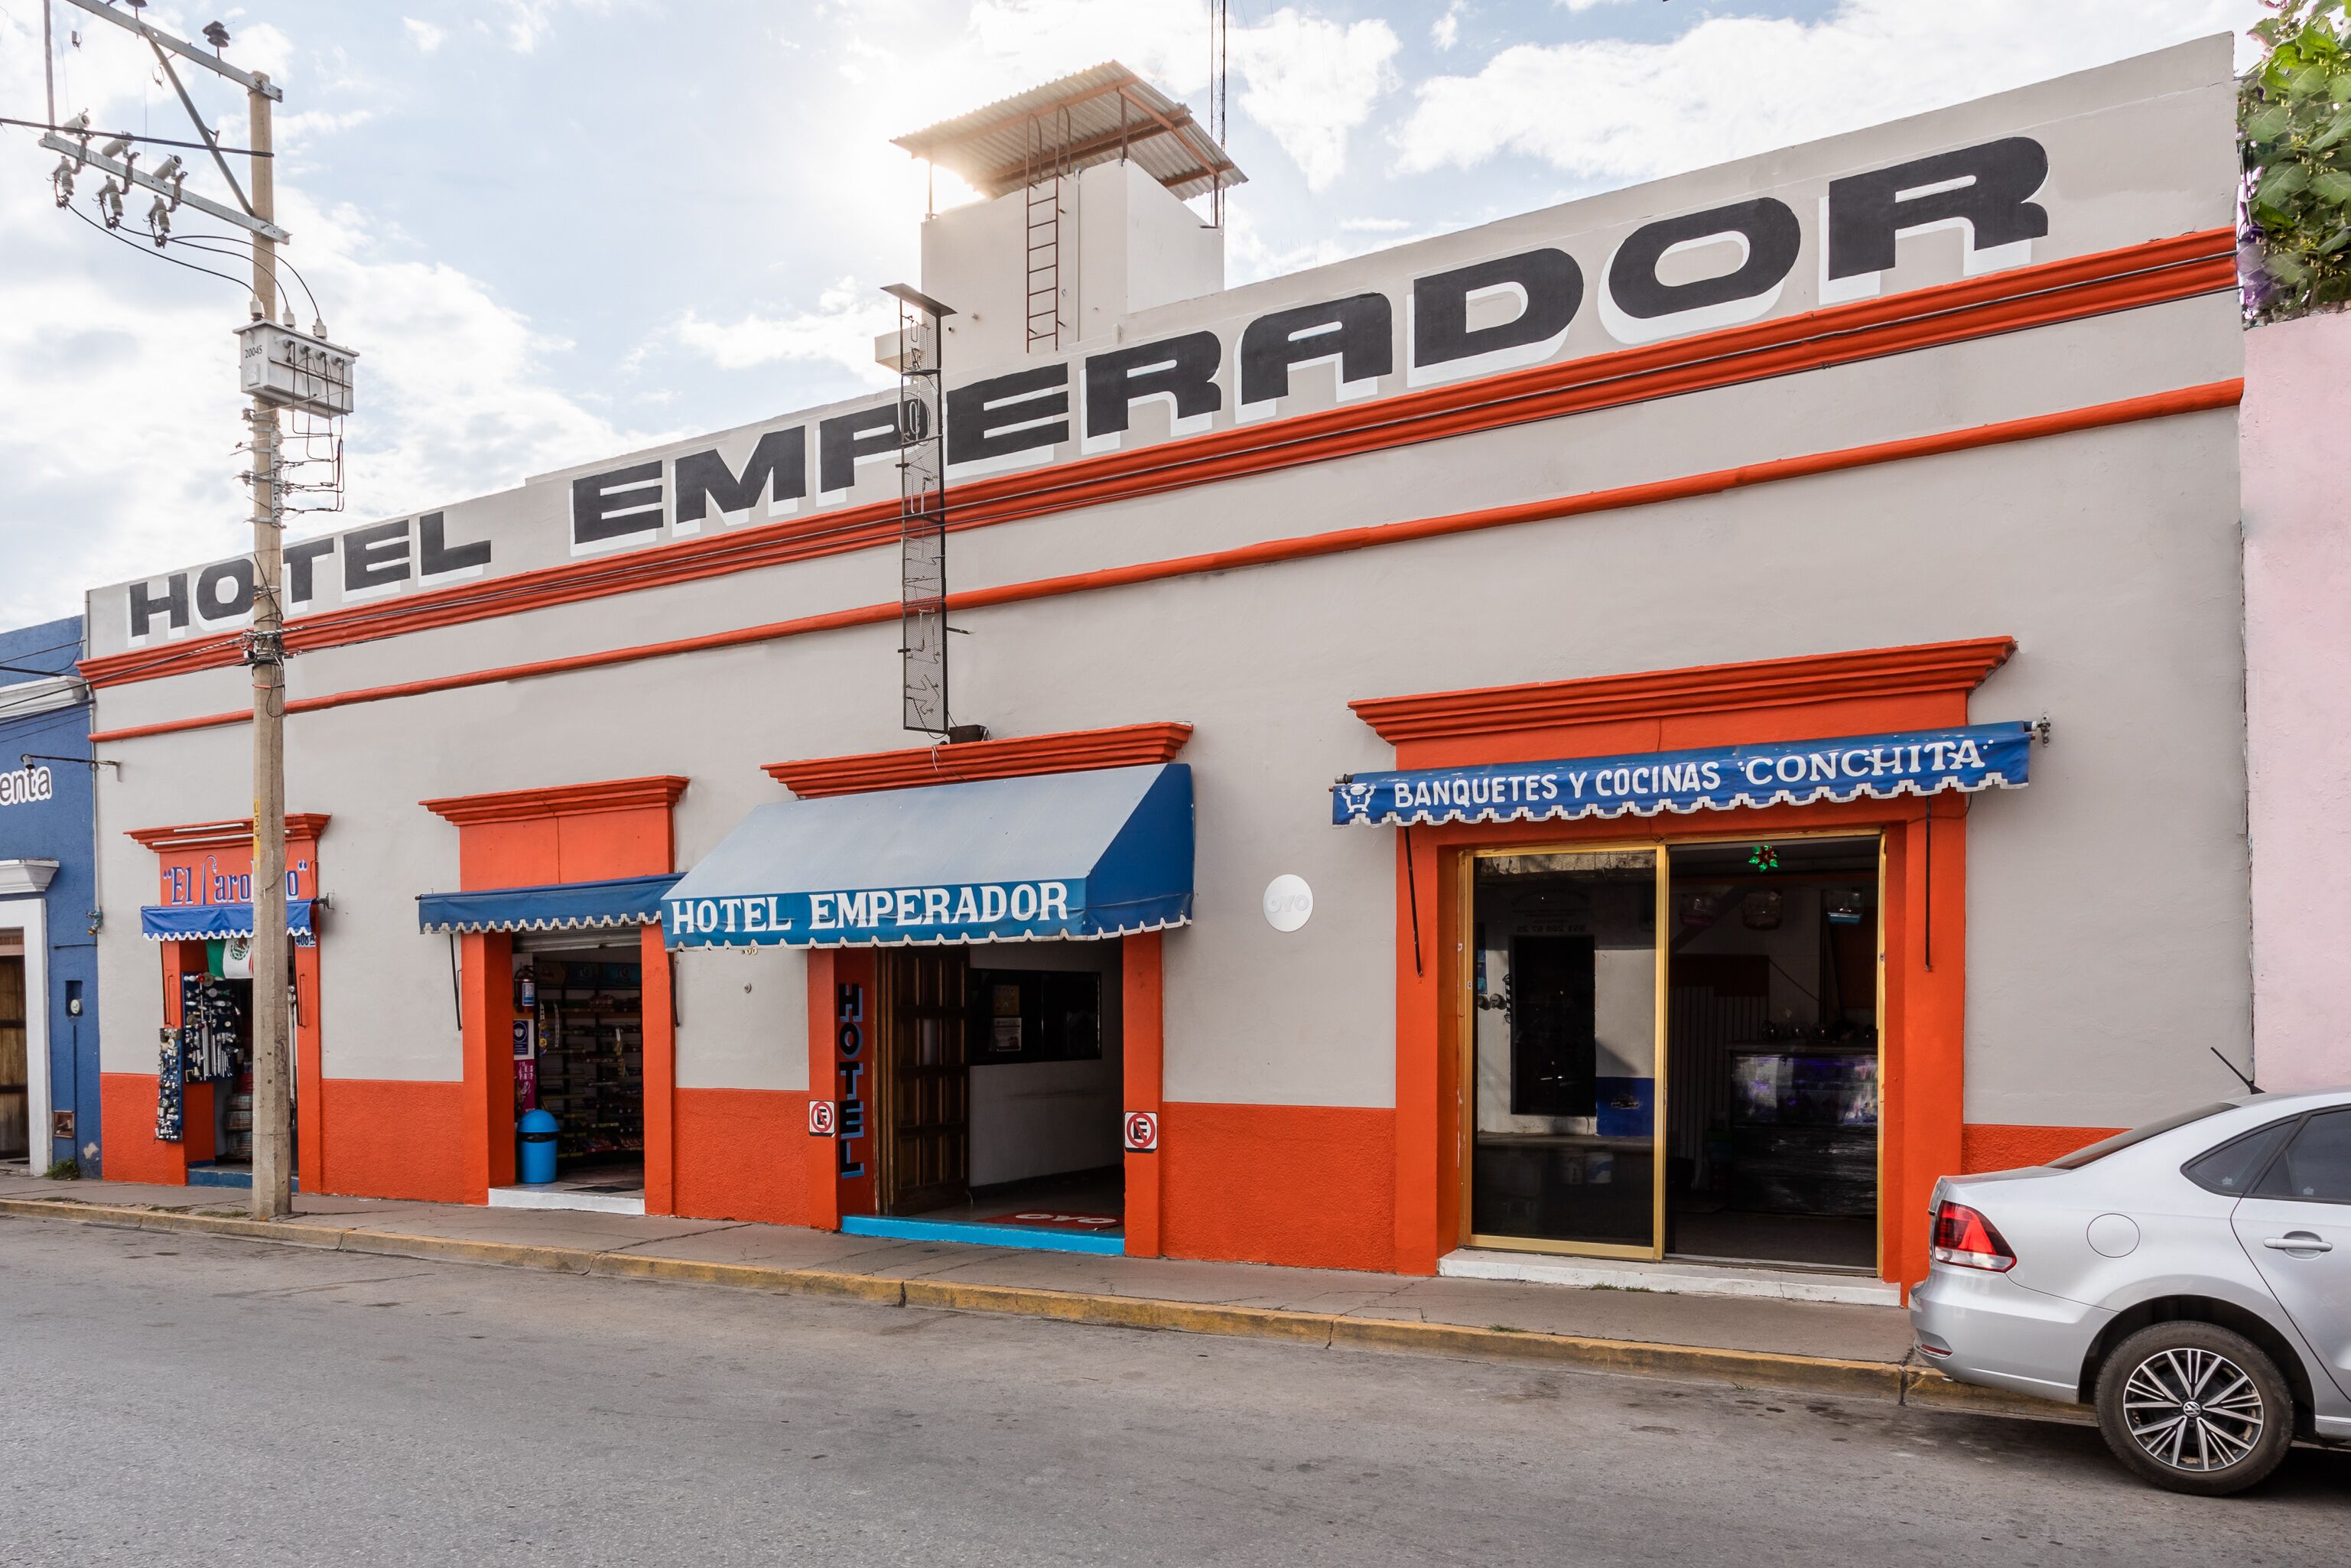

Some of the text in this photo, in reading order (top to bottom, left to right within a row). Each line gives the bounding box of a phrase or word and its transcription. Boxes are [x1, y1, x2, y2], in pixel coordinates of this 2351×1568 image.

[245, 344, 263, 359] 20045
[128, 511, 492, 646] HOTEL
[571, 137, 2049, 548] EMPERADOR
[1394, 740, 1985, 808] BANQUETES Y COCINAS CONCHITA
[671, 881, 1068, 935] HOTEL EMPERADOR
[1267, 893, 1310, 913] OYO
[838, 983, 865, 1179] HOTEL
[1133, 1121, 1147, 1140] E
[1015, 1214, 1117, 1224] OYO
